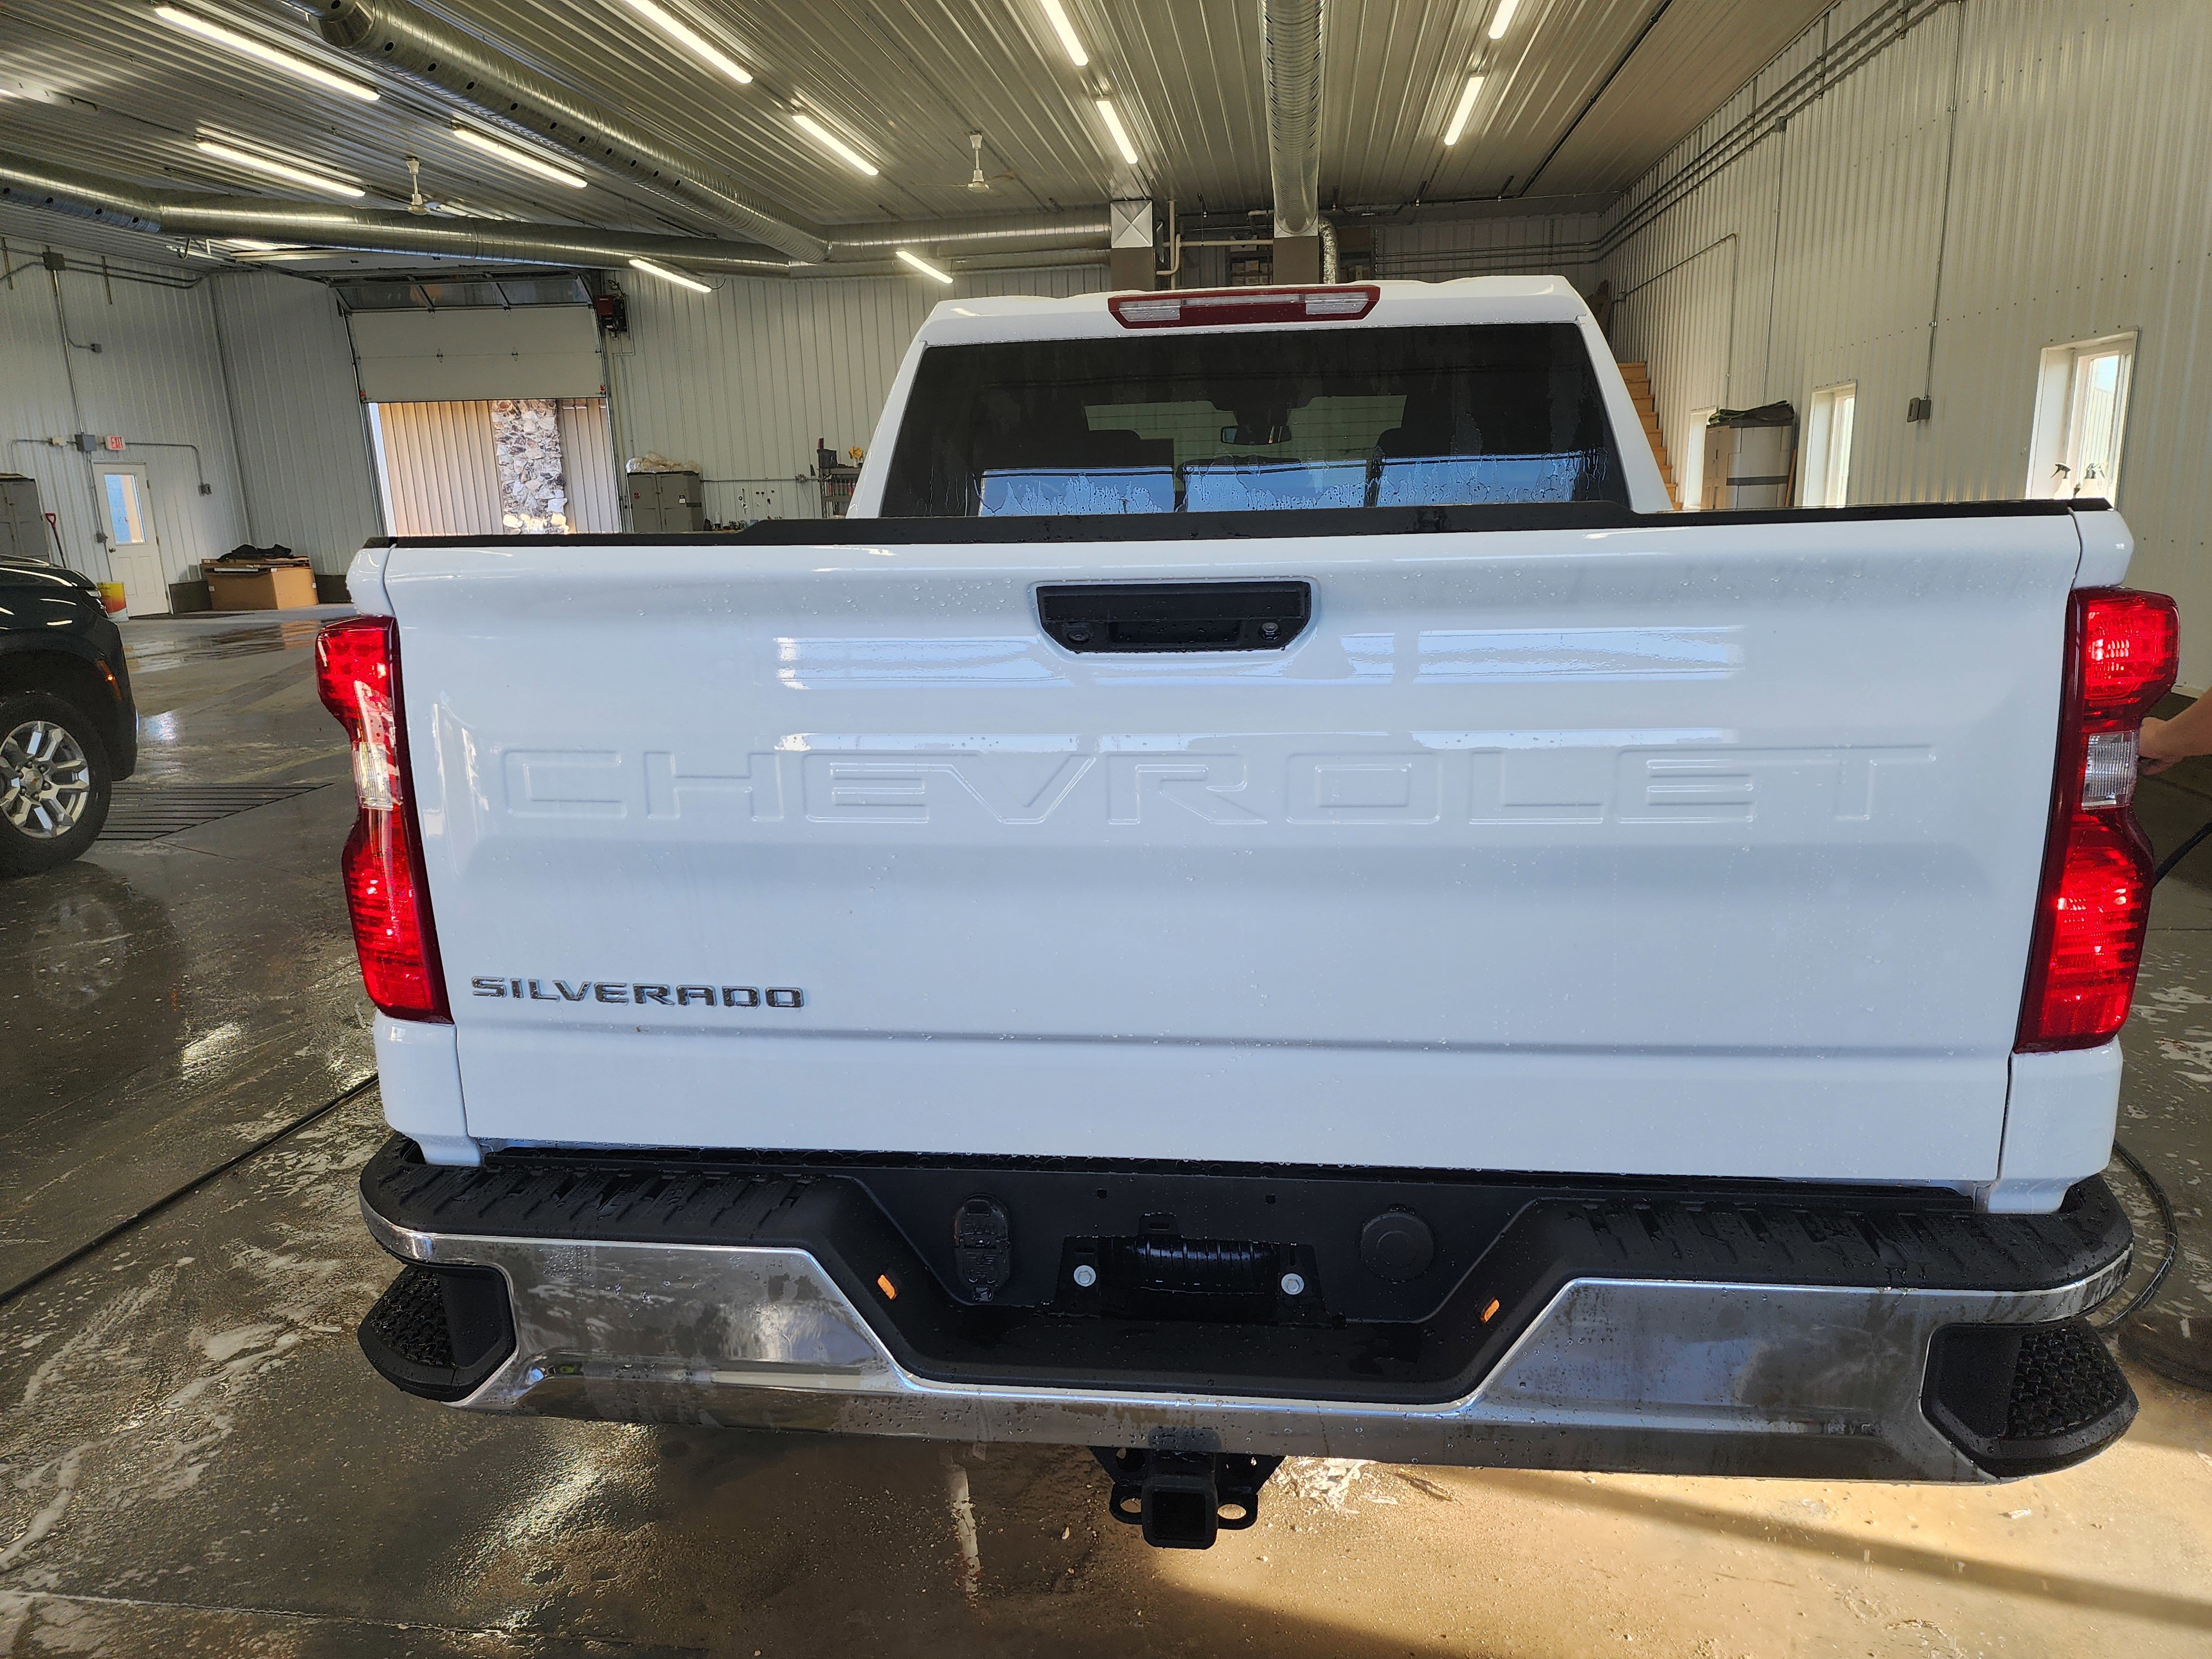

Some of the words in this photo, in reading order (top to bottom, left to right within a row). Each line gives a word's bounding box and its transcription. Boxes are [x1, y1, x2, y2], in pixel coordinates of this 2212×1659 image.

[111, 436, 123, 449] EXIT
[500, 744, 1938, 826] CHEVROLET
[471, 975, 805, 1008] SILVERADO
